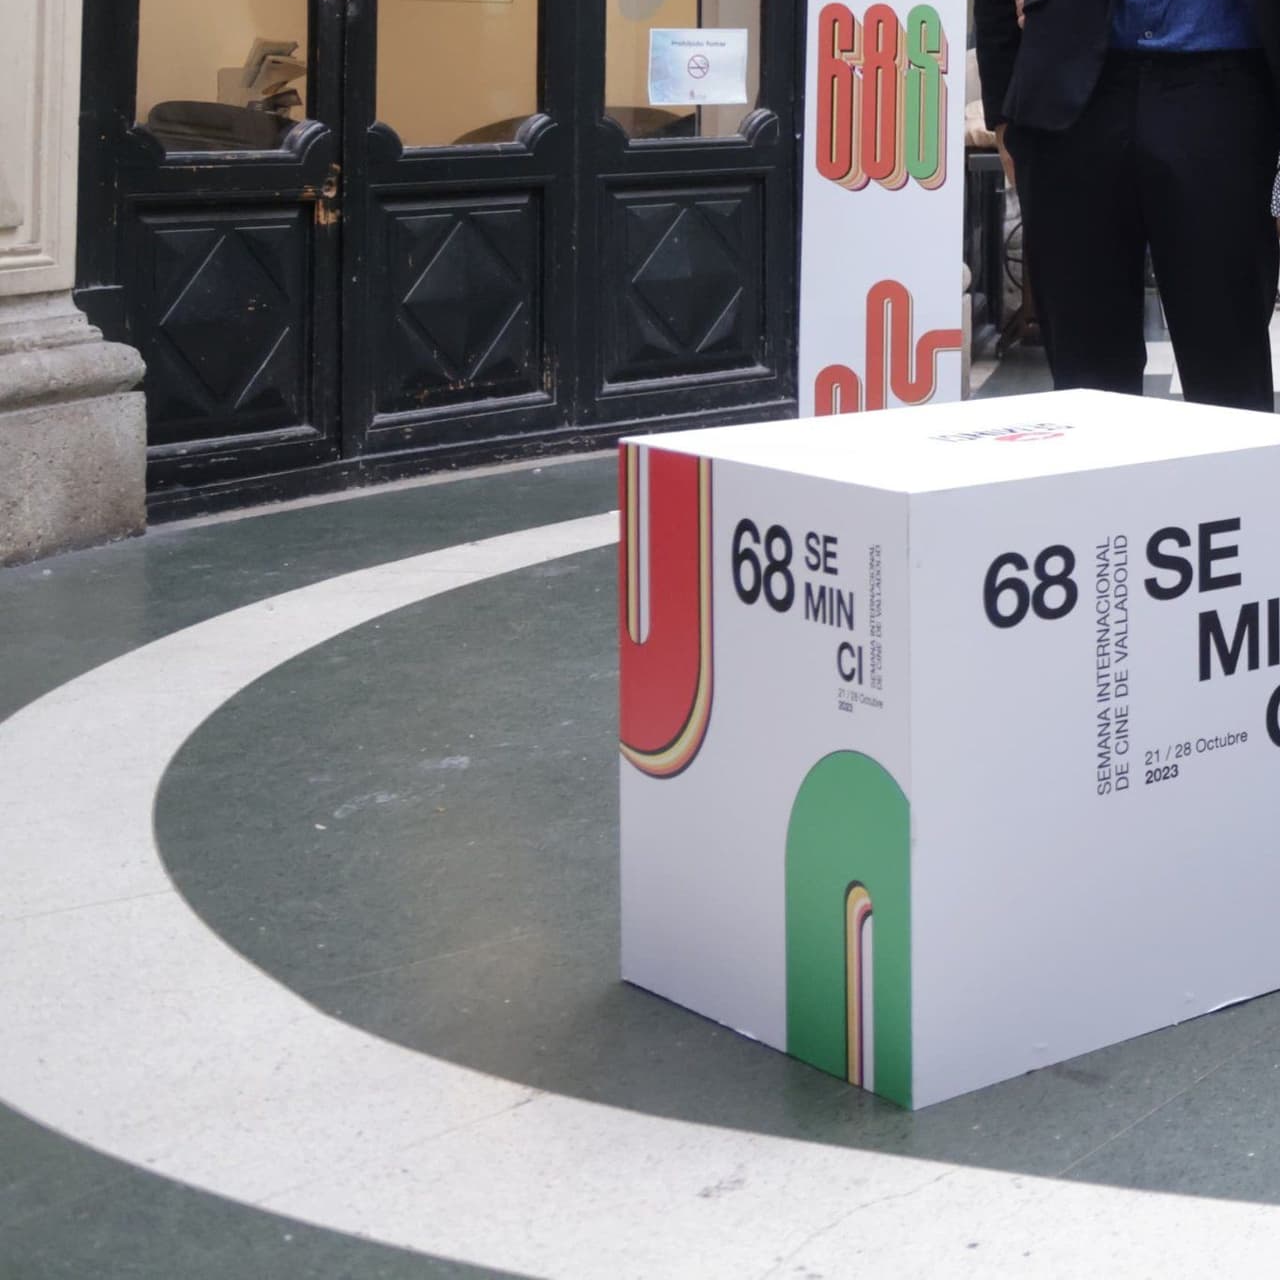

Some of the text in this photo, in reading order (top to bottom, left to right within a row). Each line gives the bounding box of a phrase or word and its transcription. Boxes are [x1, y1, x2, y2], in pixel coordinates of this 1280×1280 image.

[731, 518, 795, 613] 68
[804, 531, 838, 576] SE
[1144, 517, 1242, 601] SE
[804, 582, 854, 631] MIN
[982, 545, 1079, 629] 68
[837, 641, 863, 686] CI
[1096, 536, 1112, 796] SEMANA INTERNACIONAL
[1114, 534, 1129, 792] DE CINE DE VALLADOLID
[1144, 750, 1161, 766] 21
[1174, 743, 1192, 759] 28
[1196, 730, 1249, 754] Octubre
[1144, 763, 1180, 785] 2023
